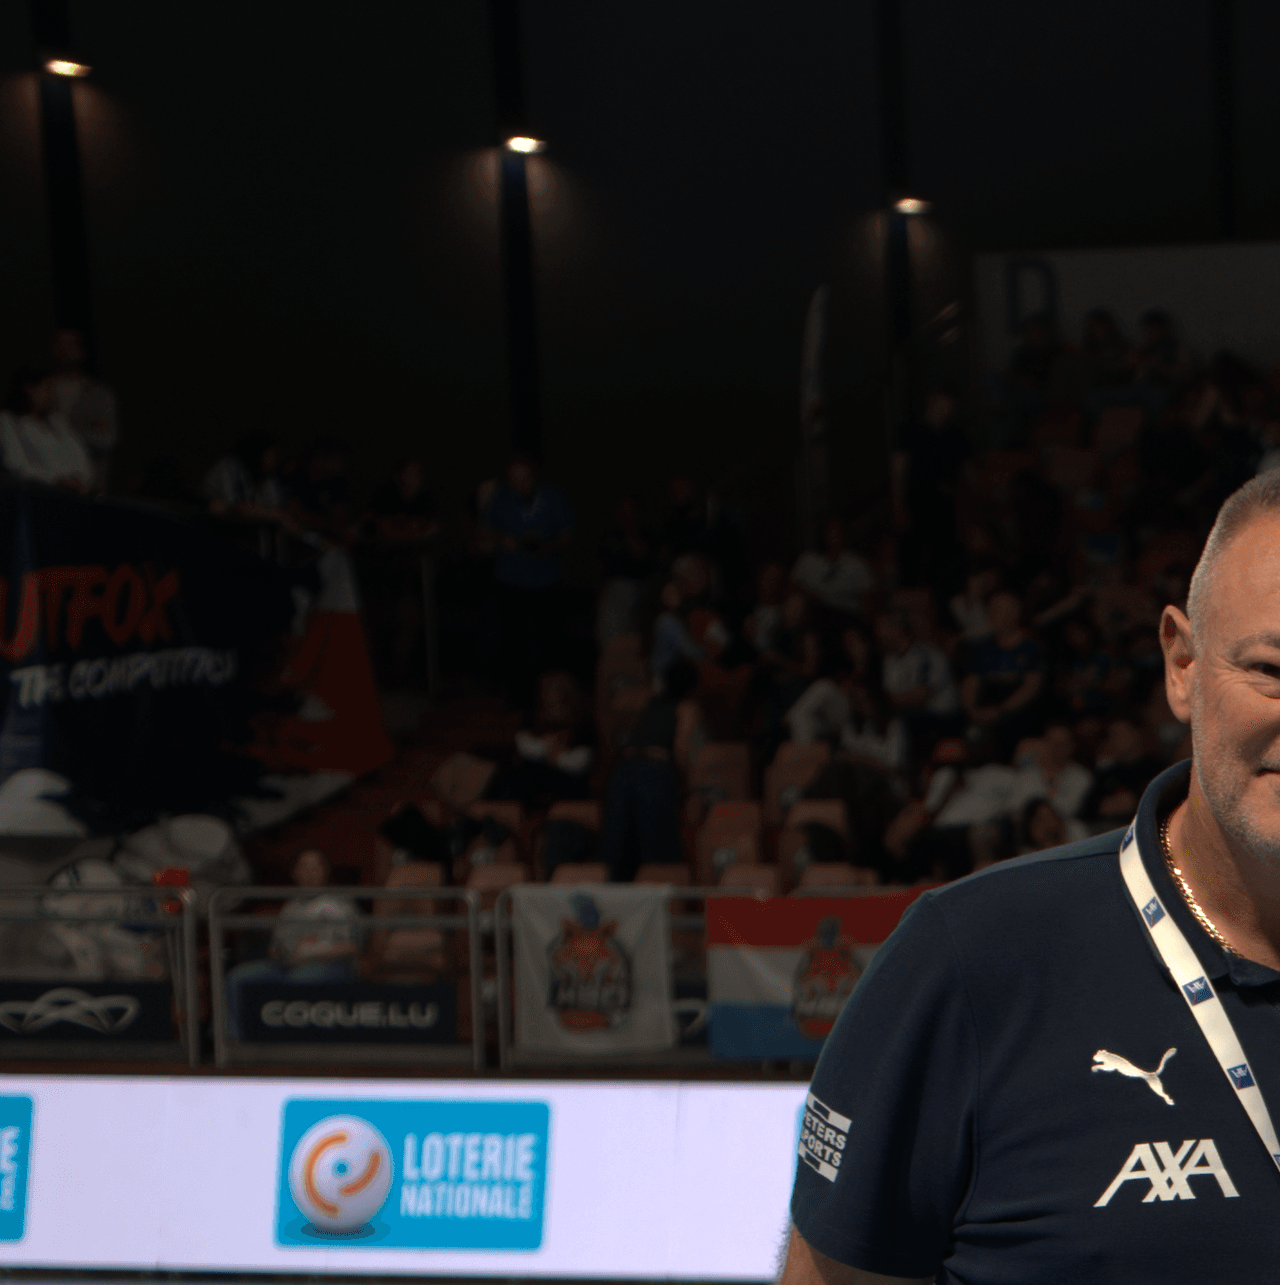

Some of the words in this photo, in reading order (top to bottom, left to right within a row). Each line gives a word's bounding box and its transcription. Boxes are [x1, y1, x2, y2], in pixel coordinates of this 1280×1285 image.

[260, 999, 440, 1030] COQUE.LU
[801, 1128, 842, 1167] PORTS
[802, 1110, 847, 1151] ETERS
[403, 1131, 538, 1181] LOTERIE
[1093, 1138, 1240, 1208] AXA
[400, 1182, 533, 1219] NATIONALE
